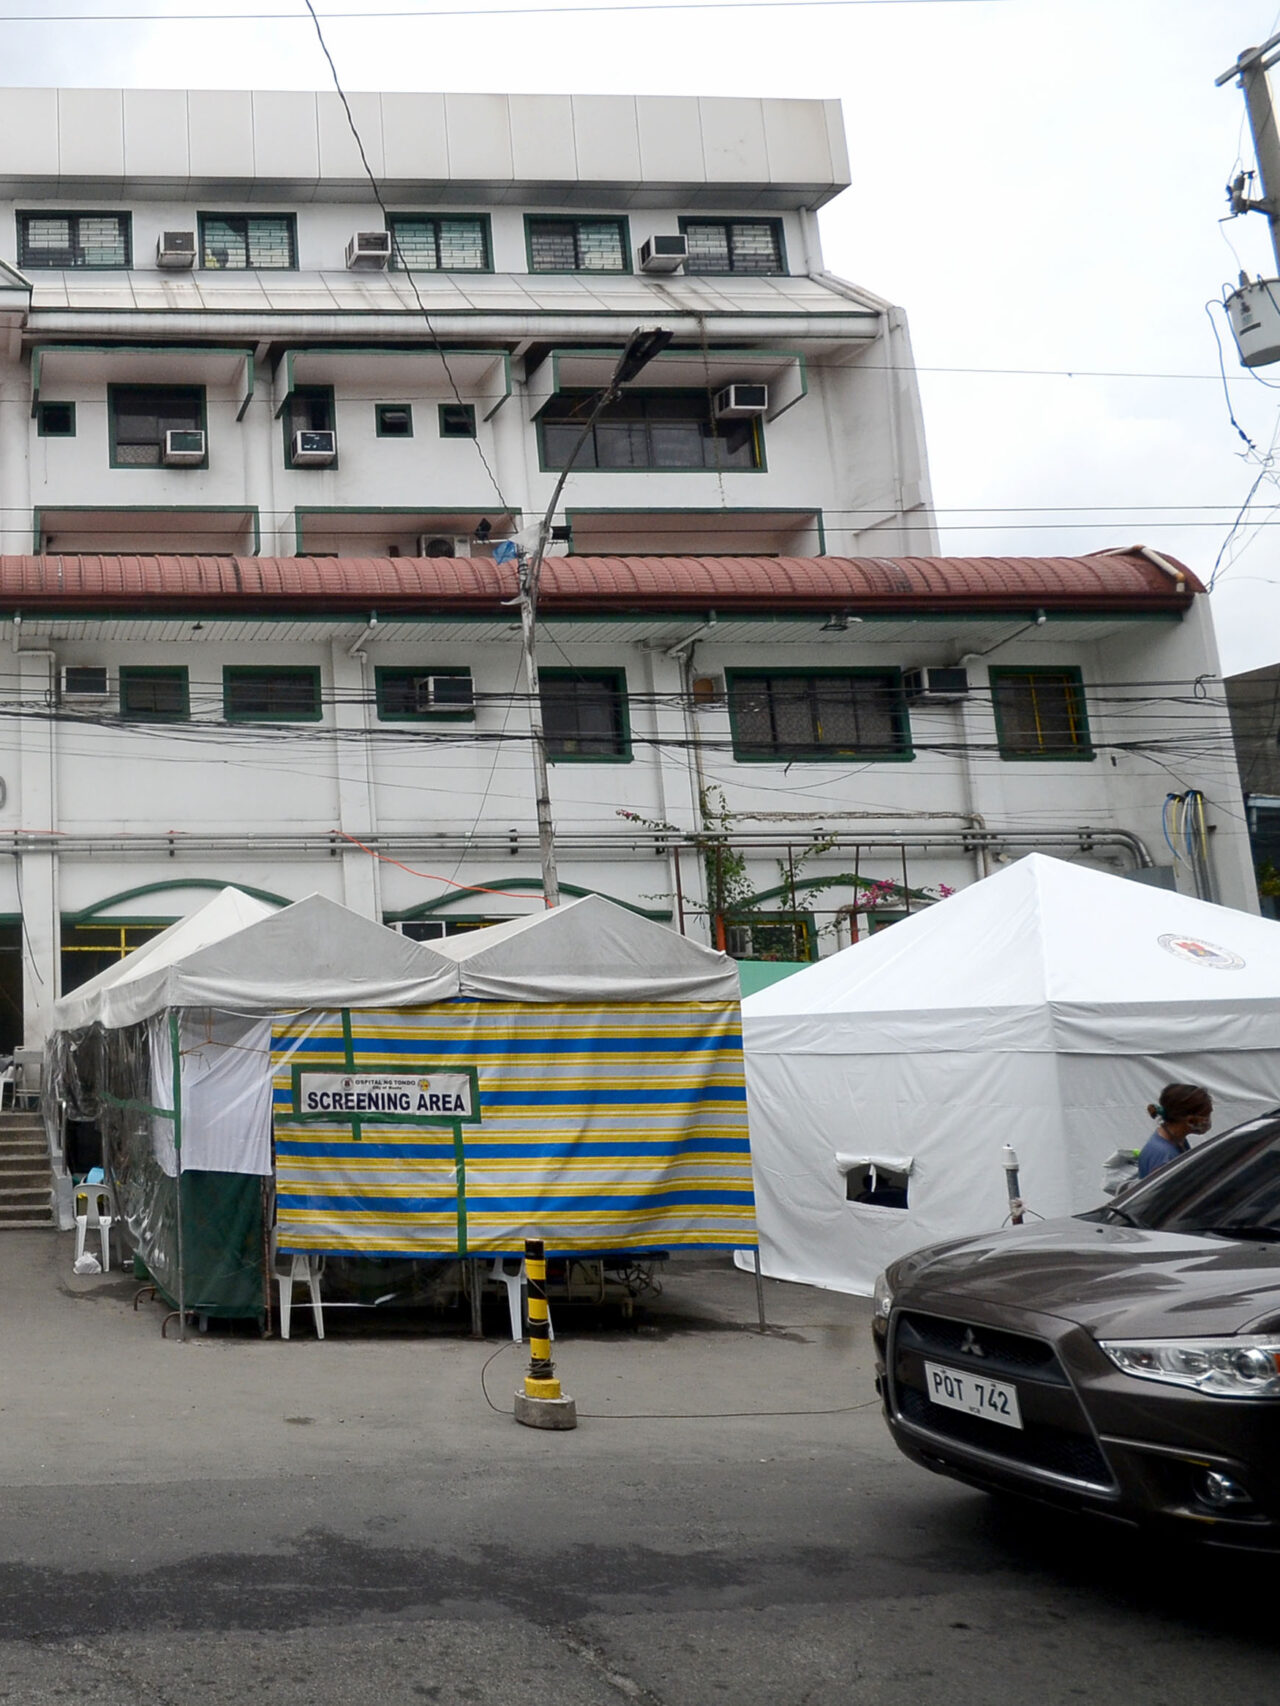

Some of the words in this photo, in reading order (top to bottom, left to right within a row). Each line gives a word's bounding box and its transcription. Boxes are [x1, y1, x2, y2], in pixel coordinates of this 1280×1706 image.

[307, 1091, 411, 1111] SCREENING
[417, 1093, 466, 1112] AREA
[974, 1384, 1011, 1415] 742
